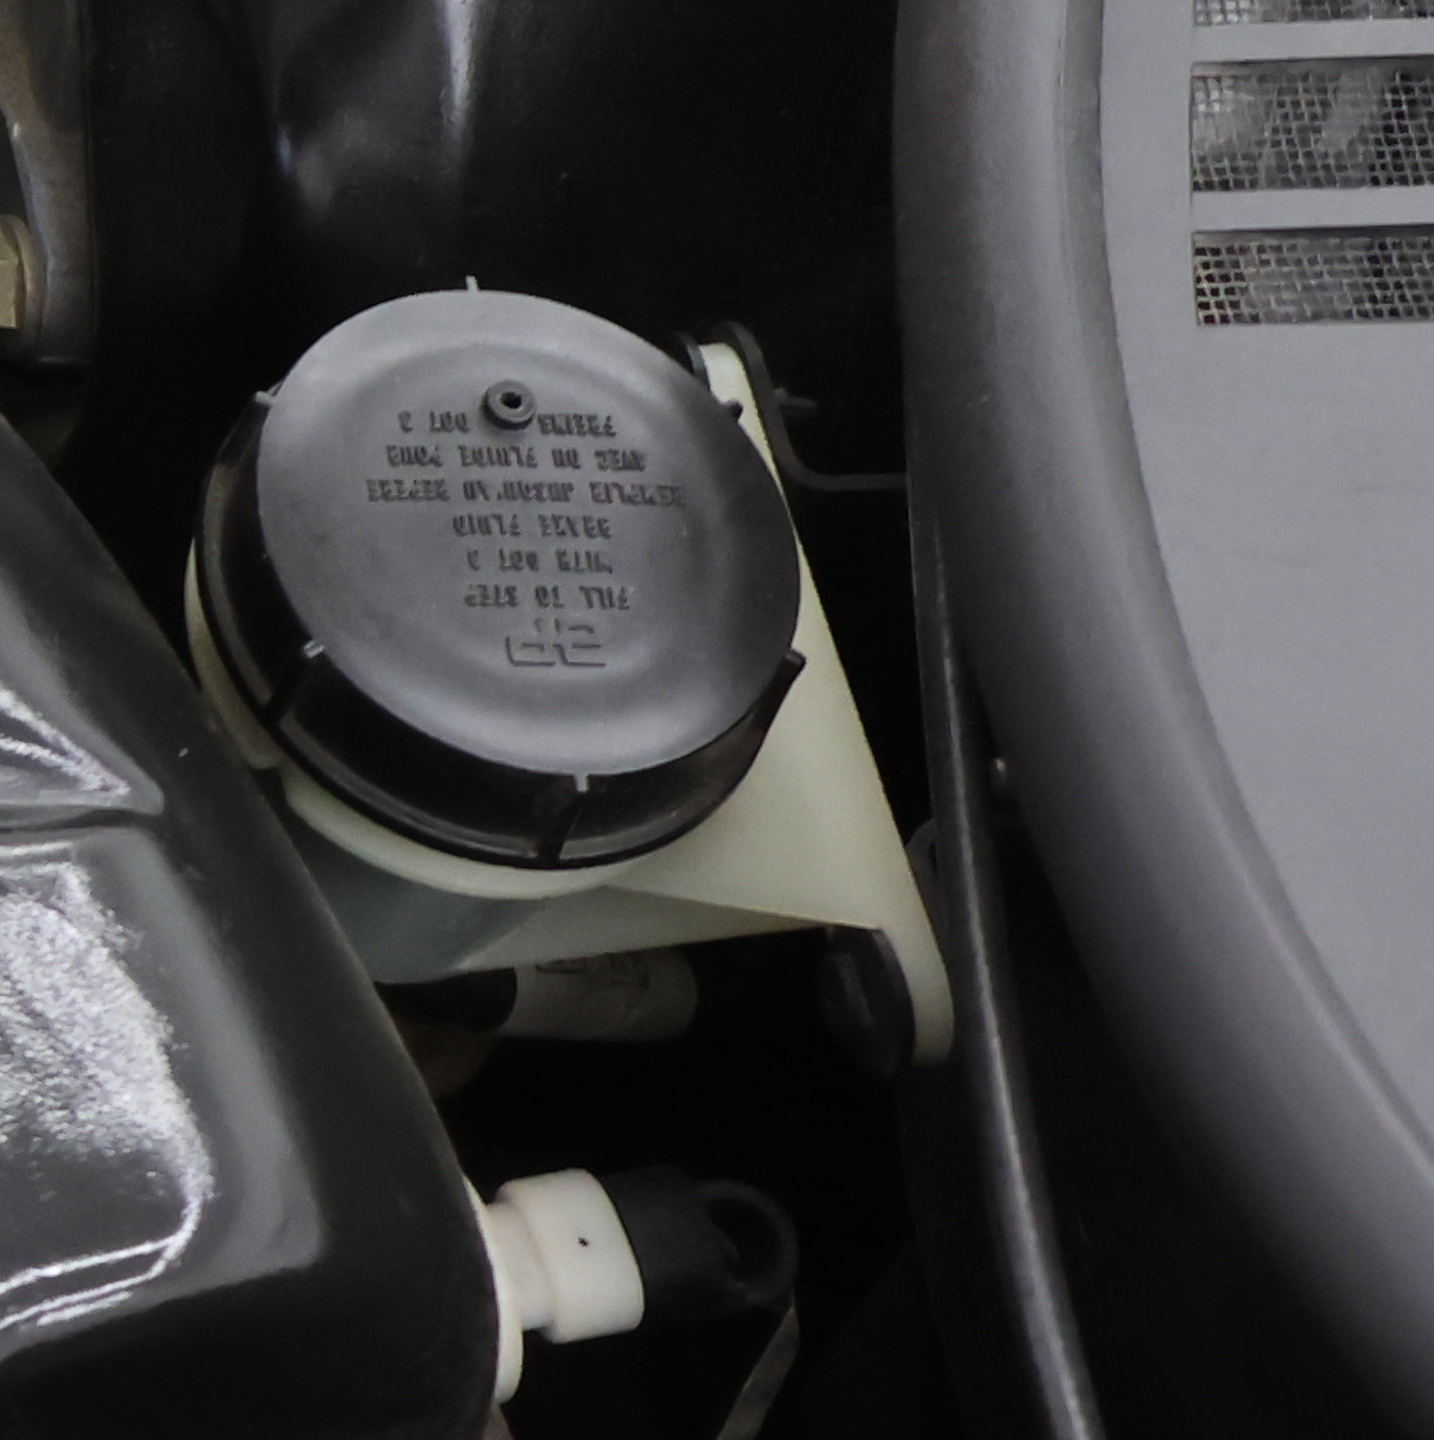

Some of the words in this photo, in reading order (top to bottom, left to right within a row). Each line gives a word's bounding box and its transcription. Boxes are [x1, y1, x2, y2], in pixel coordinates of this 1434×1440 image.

[429, 411, 470, 434] DOT
[458, 445, 538, 468] FLUIDE
[551, 448, 581, 469] DU
[452, 513, 522, 537] FLUID
[539, 514, 612, 539] BRAKE
[499, 549, 538, 572] DOT
[465, 584, 519, 609] STEP
[535, 585, 565, 609] TO
[579, 586, 630, 611] FILL
